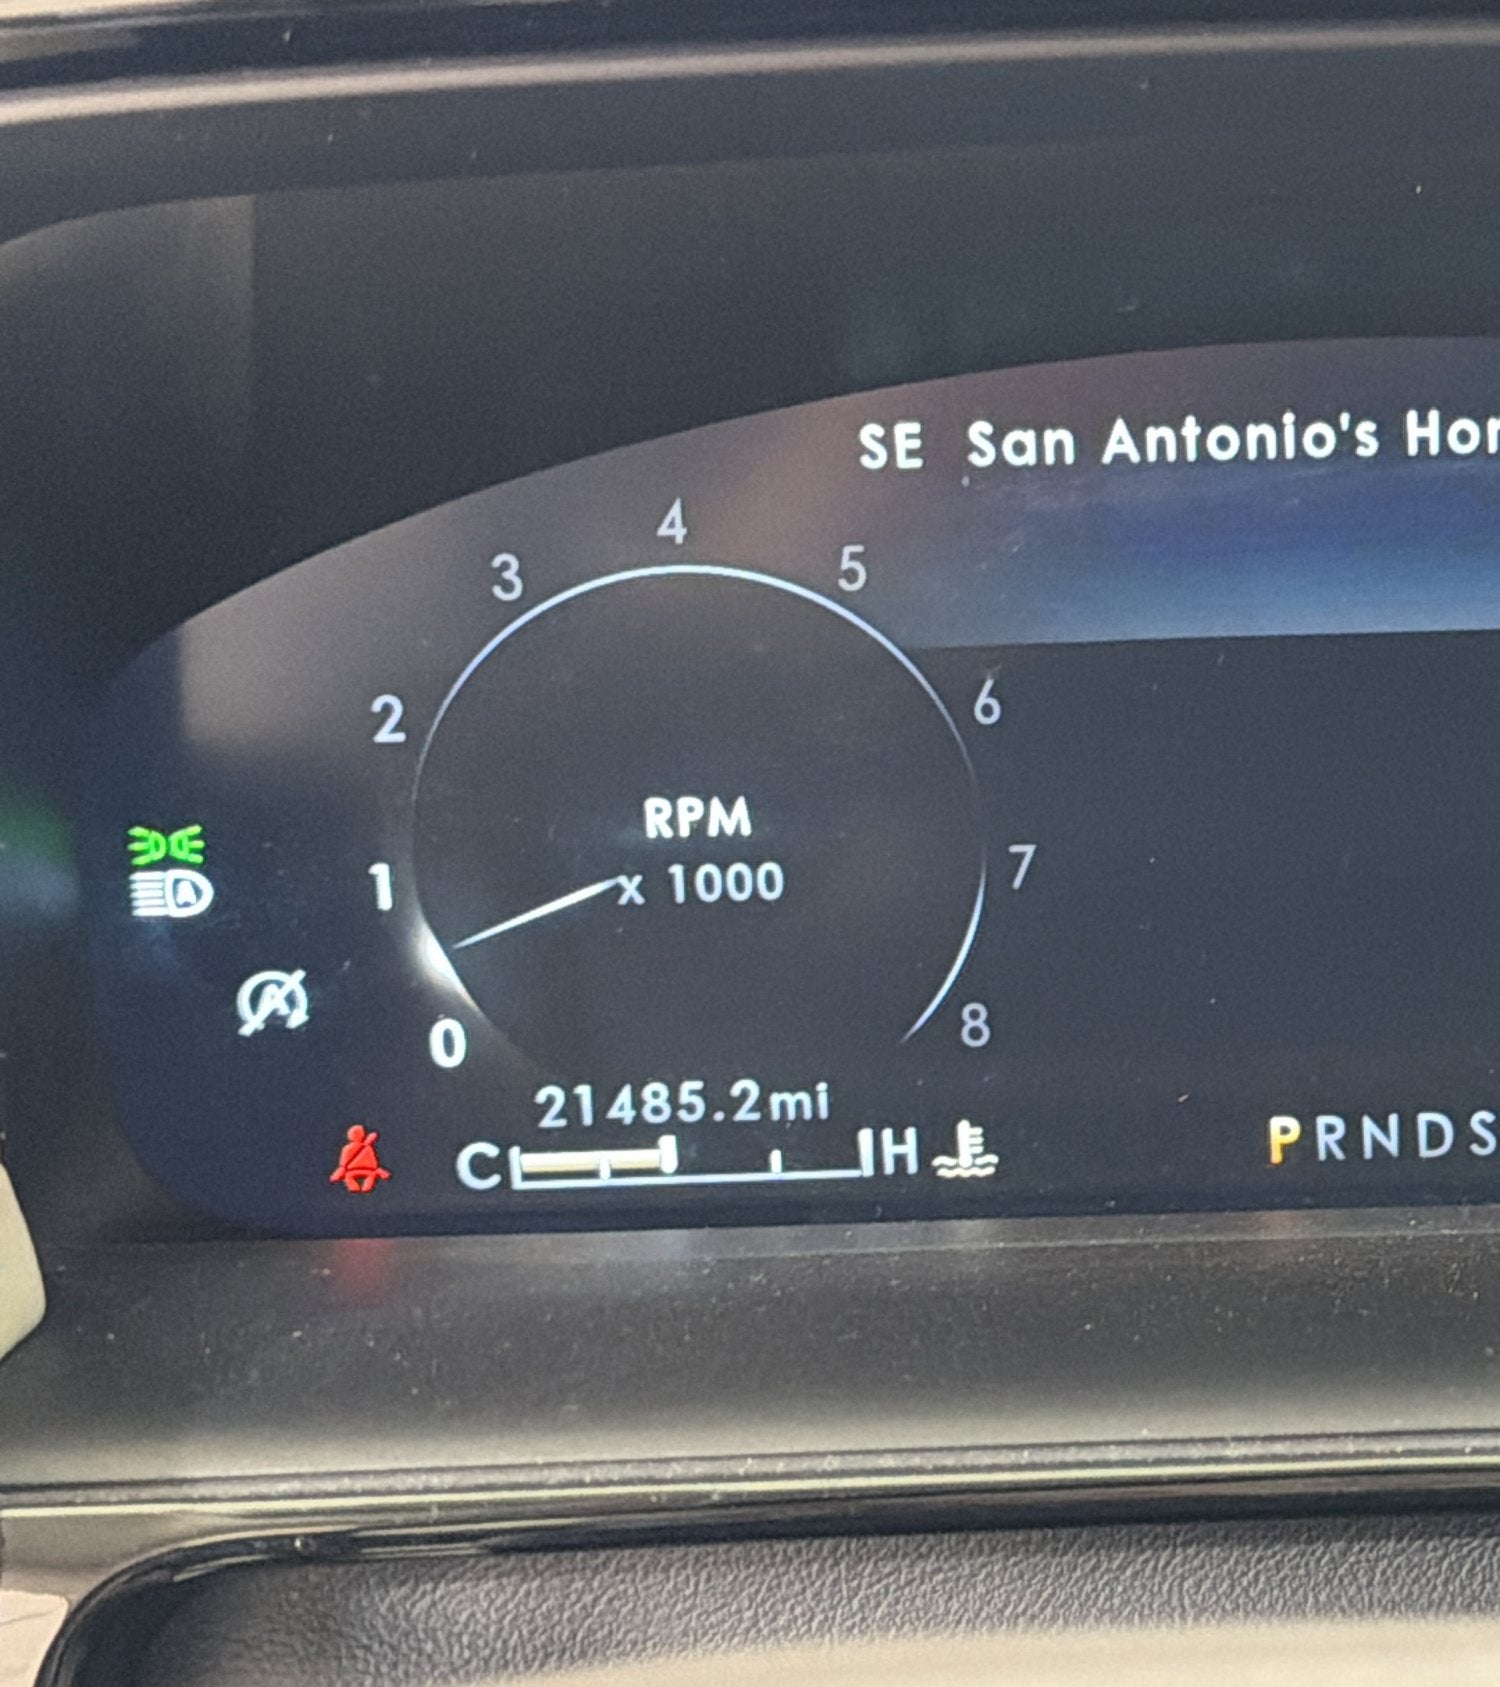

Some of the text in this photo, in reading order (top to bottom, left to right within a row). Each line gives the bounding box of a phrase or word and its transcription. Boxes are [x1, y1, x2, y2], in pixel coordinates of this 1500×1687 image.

[859, 421, 924, 470] SE
[967, 420, 1075, 468] San
[1101, 411, 1380, 465] Antonio's
[656, 497, 688, 545] 4
[491, 552, 523, 601] 3
[838, 544, 867, 592] 5
[370, 694, 407, 743] 2
[974, 677, 1002, 725] 6
[643, 795, 752, 839] RPM
[368, 862, 393, 912] 1
[668, 861, 784, 904] 1000
[1008, 844, 1037, 890] 7
[429, 1017, 467, 1068] 0
[961, 1002, 991, 1048] 8
[456, 1141, 501, 1191] C
[881, 1126, 919, 1176] H
